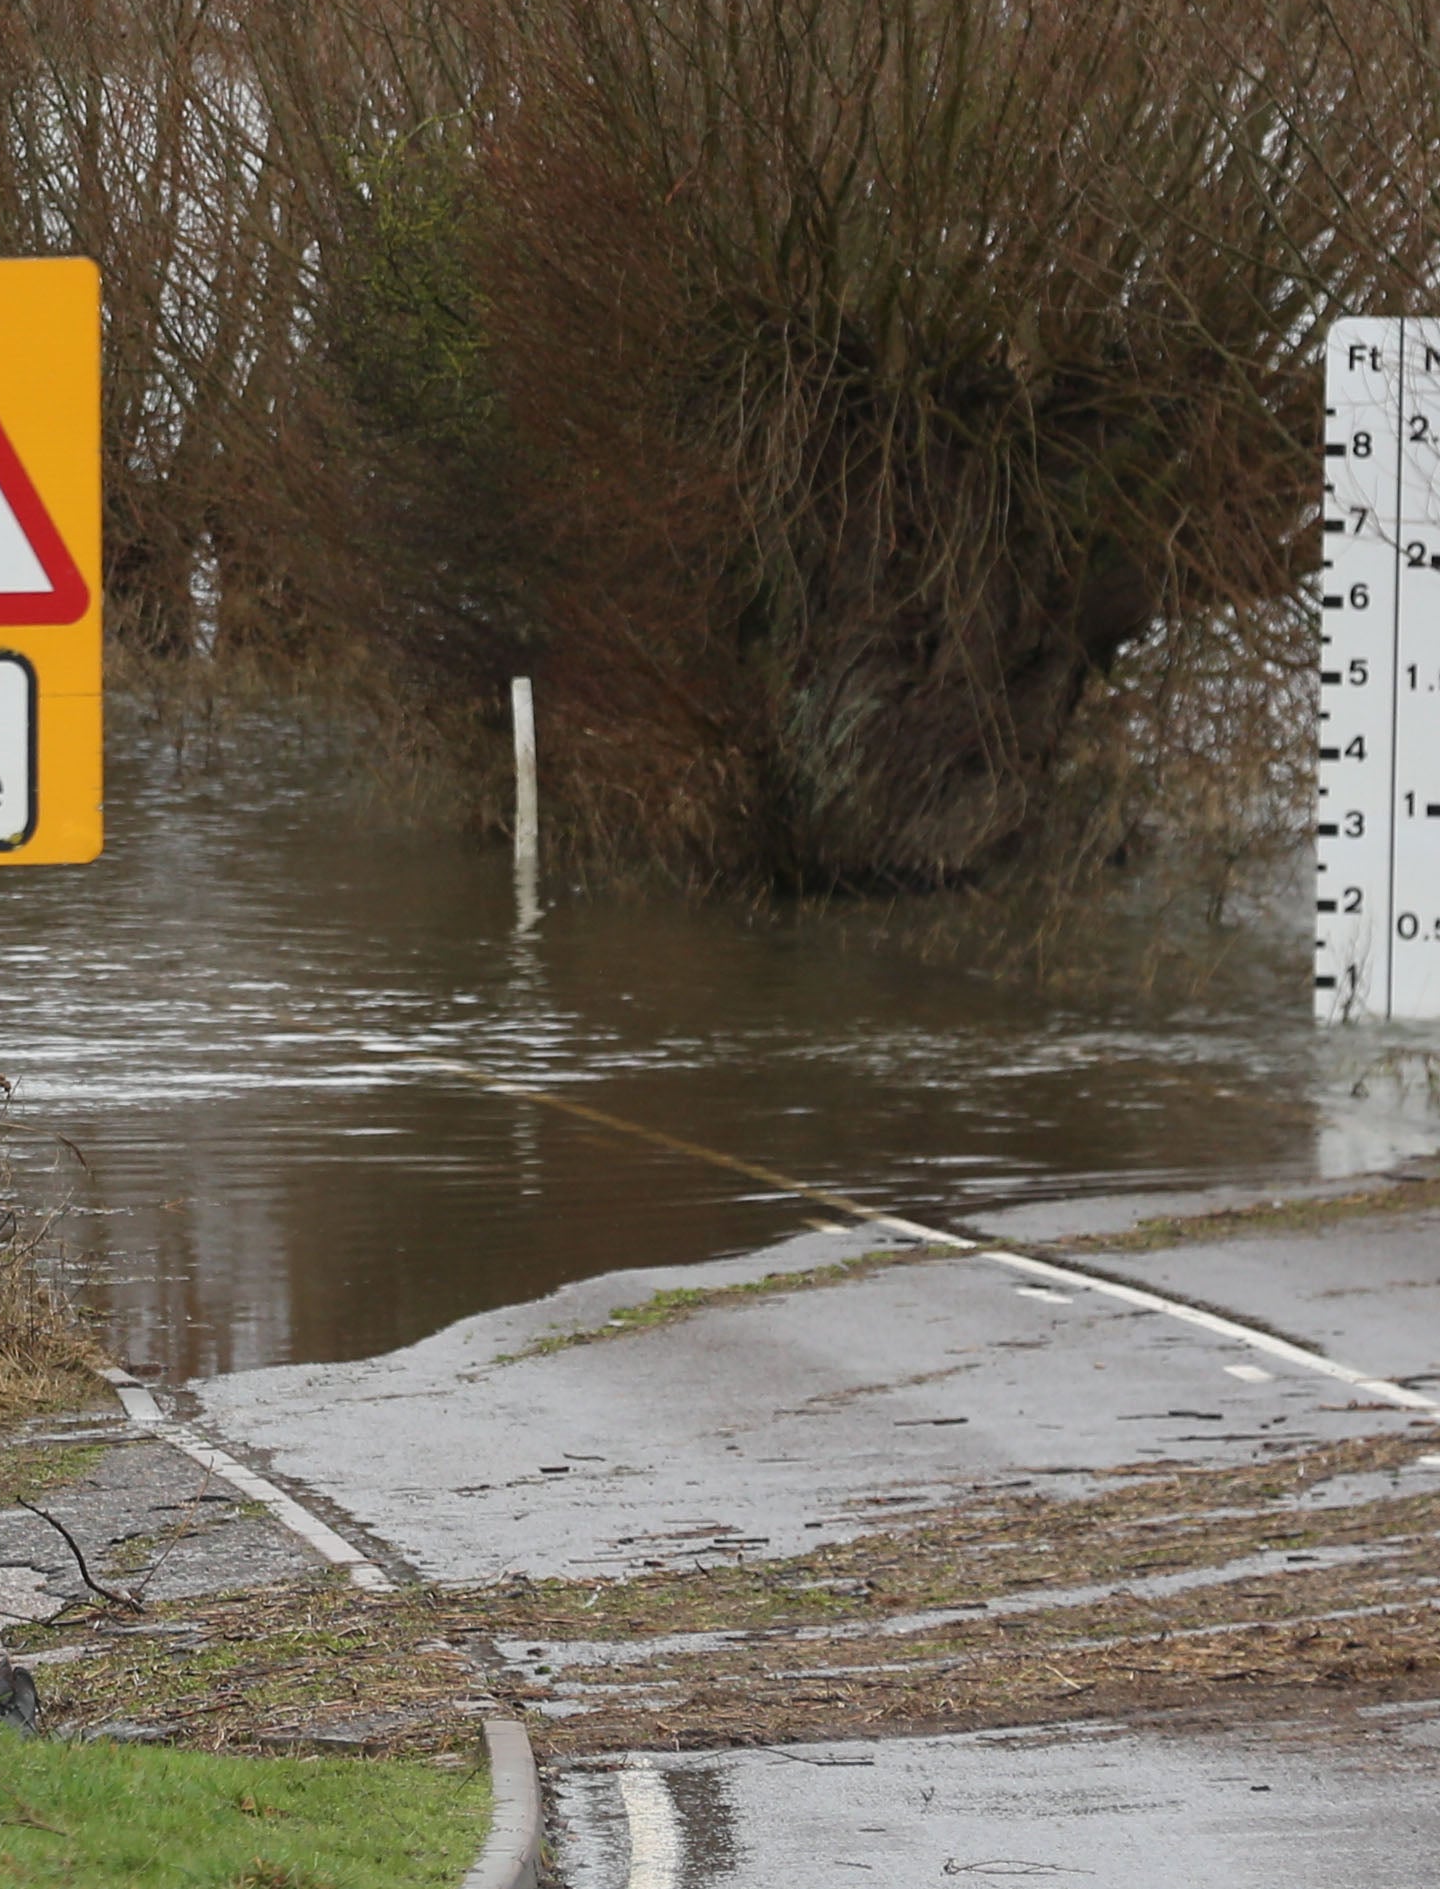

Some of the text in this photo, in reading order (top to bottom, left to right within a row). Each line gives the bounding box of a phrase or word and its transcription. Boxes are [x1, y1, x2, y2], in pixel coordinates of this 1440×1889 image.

[1349, 344, 1382, 372] Ft
[1352, 431, 1373, 458] 8
[1349, 507, 1368, 535] 7
[1406, 541, 1426, 568] 2
[1349, 583, 1369, 610] 6
[1349, 659, 1368, 686] 5
[1344, 735, 1366, 761] 4
[1404, 791, 1415, 817] 1
[1345, 810, 1365, 838] 3
[1343, 887, 1363, 914] 2
[1346, 964, 1356, 990] 1
